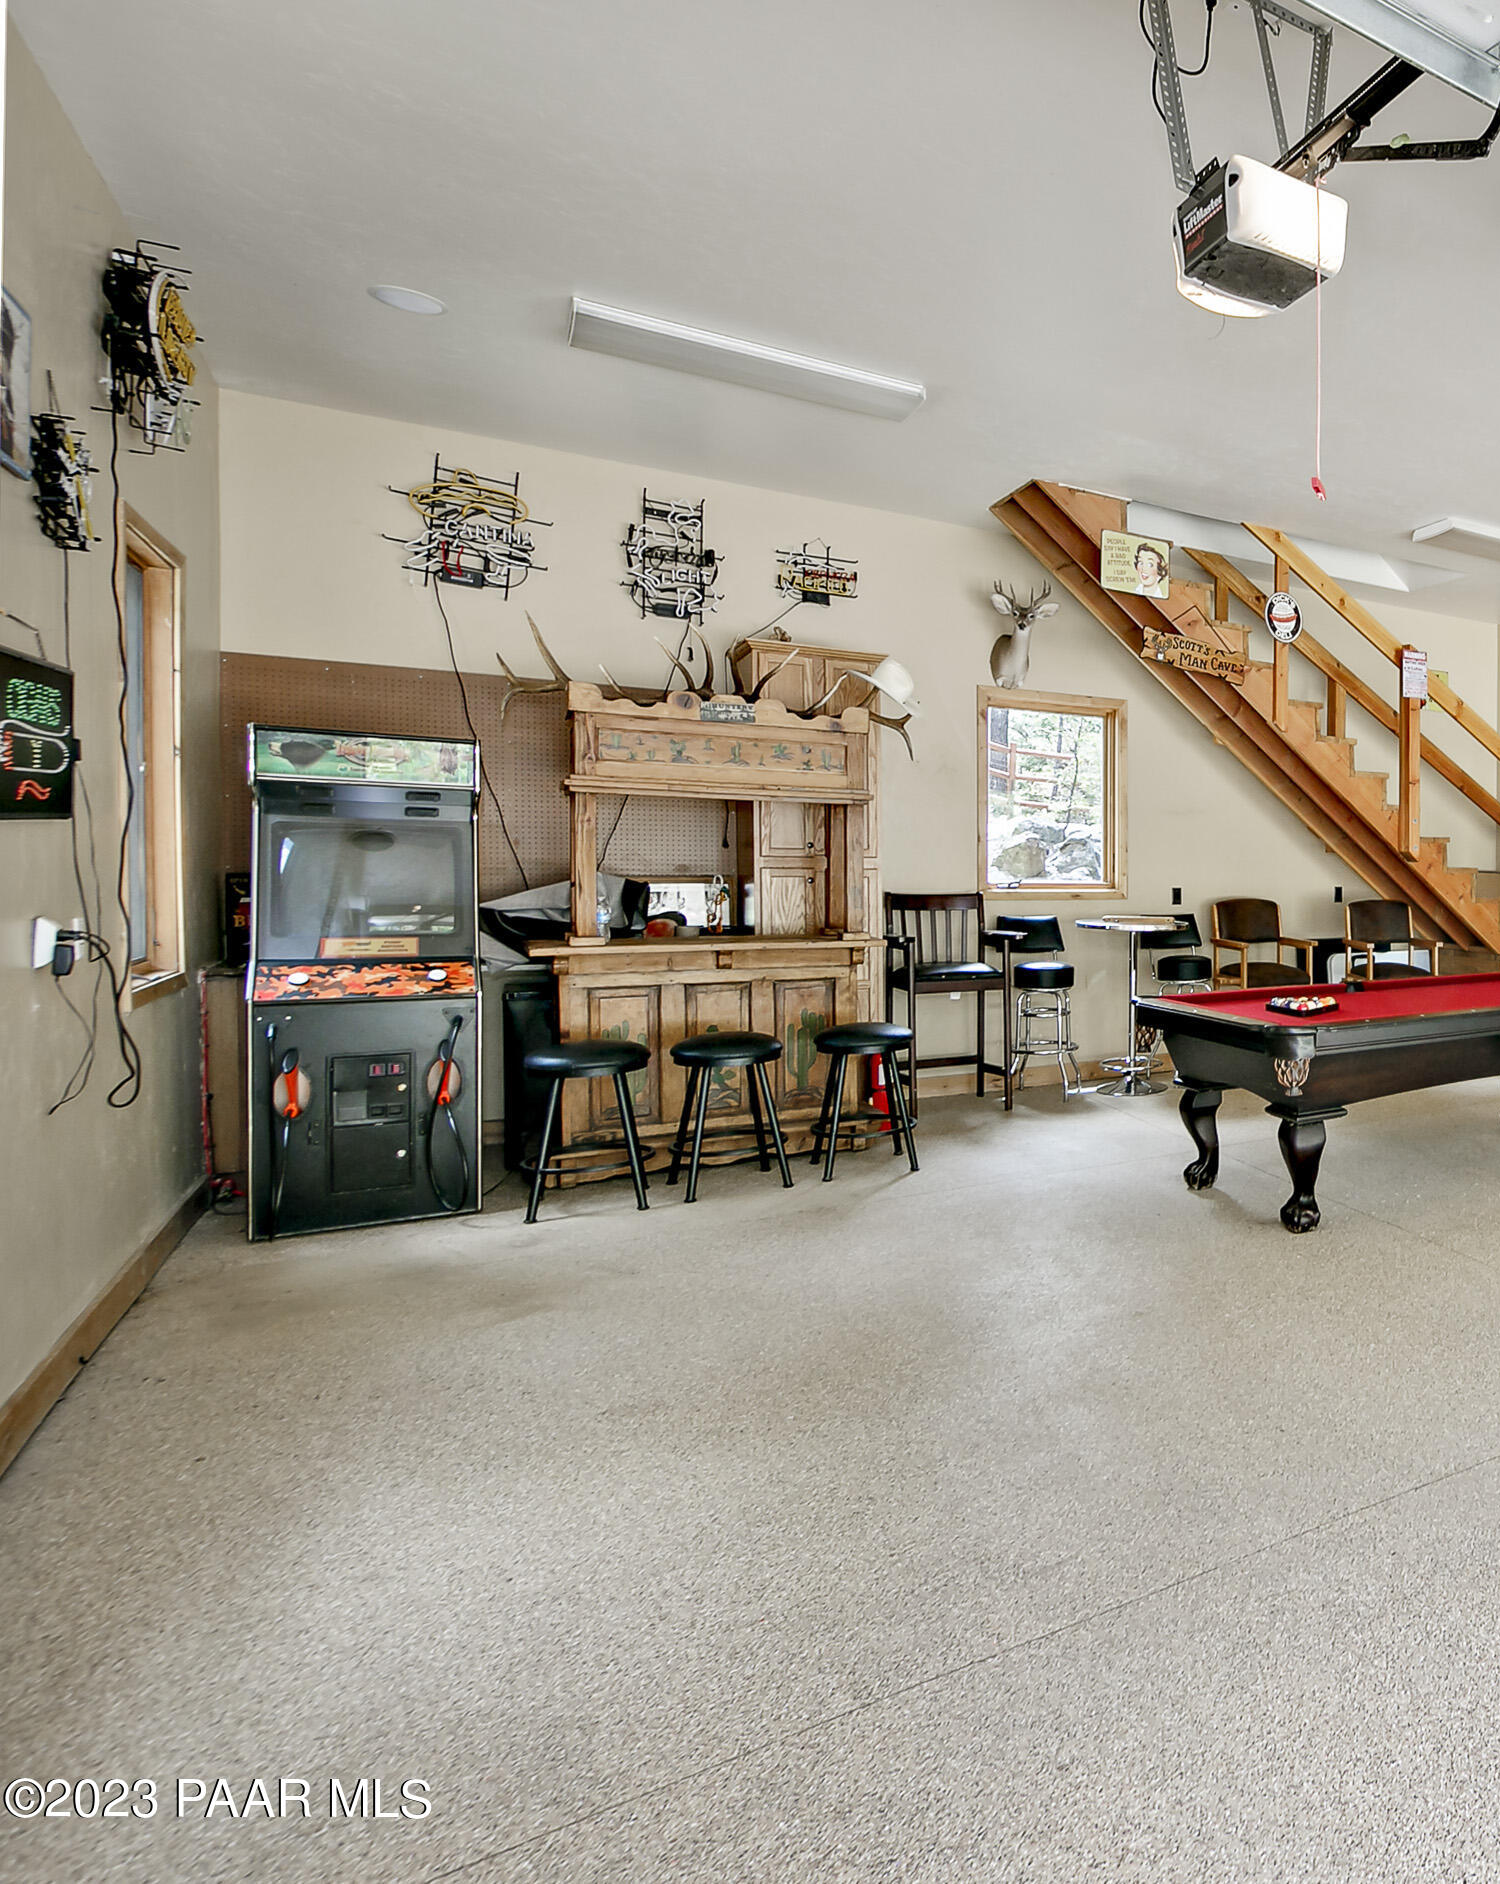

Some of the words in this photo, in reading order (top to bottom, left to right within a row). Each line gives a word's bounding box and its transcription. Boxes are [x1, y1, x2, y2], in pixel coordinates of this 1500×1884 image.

[1183, 194, 1223, 234] LiftMaster
[445, 519, 536, 548] CANTINA
[661, 569, 711, 585] LIGHT
[1172, 636, 1211, 656] SCOTT'S
[1179, 652, 1208, 670] MAN
[1210, 656, 1237, 673] CAVE
